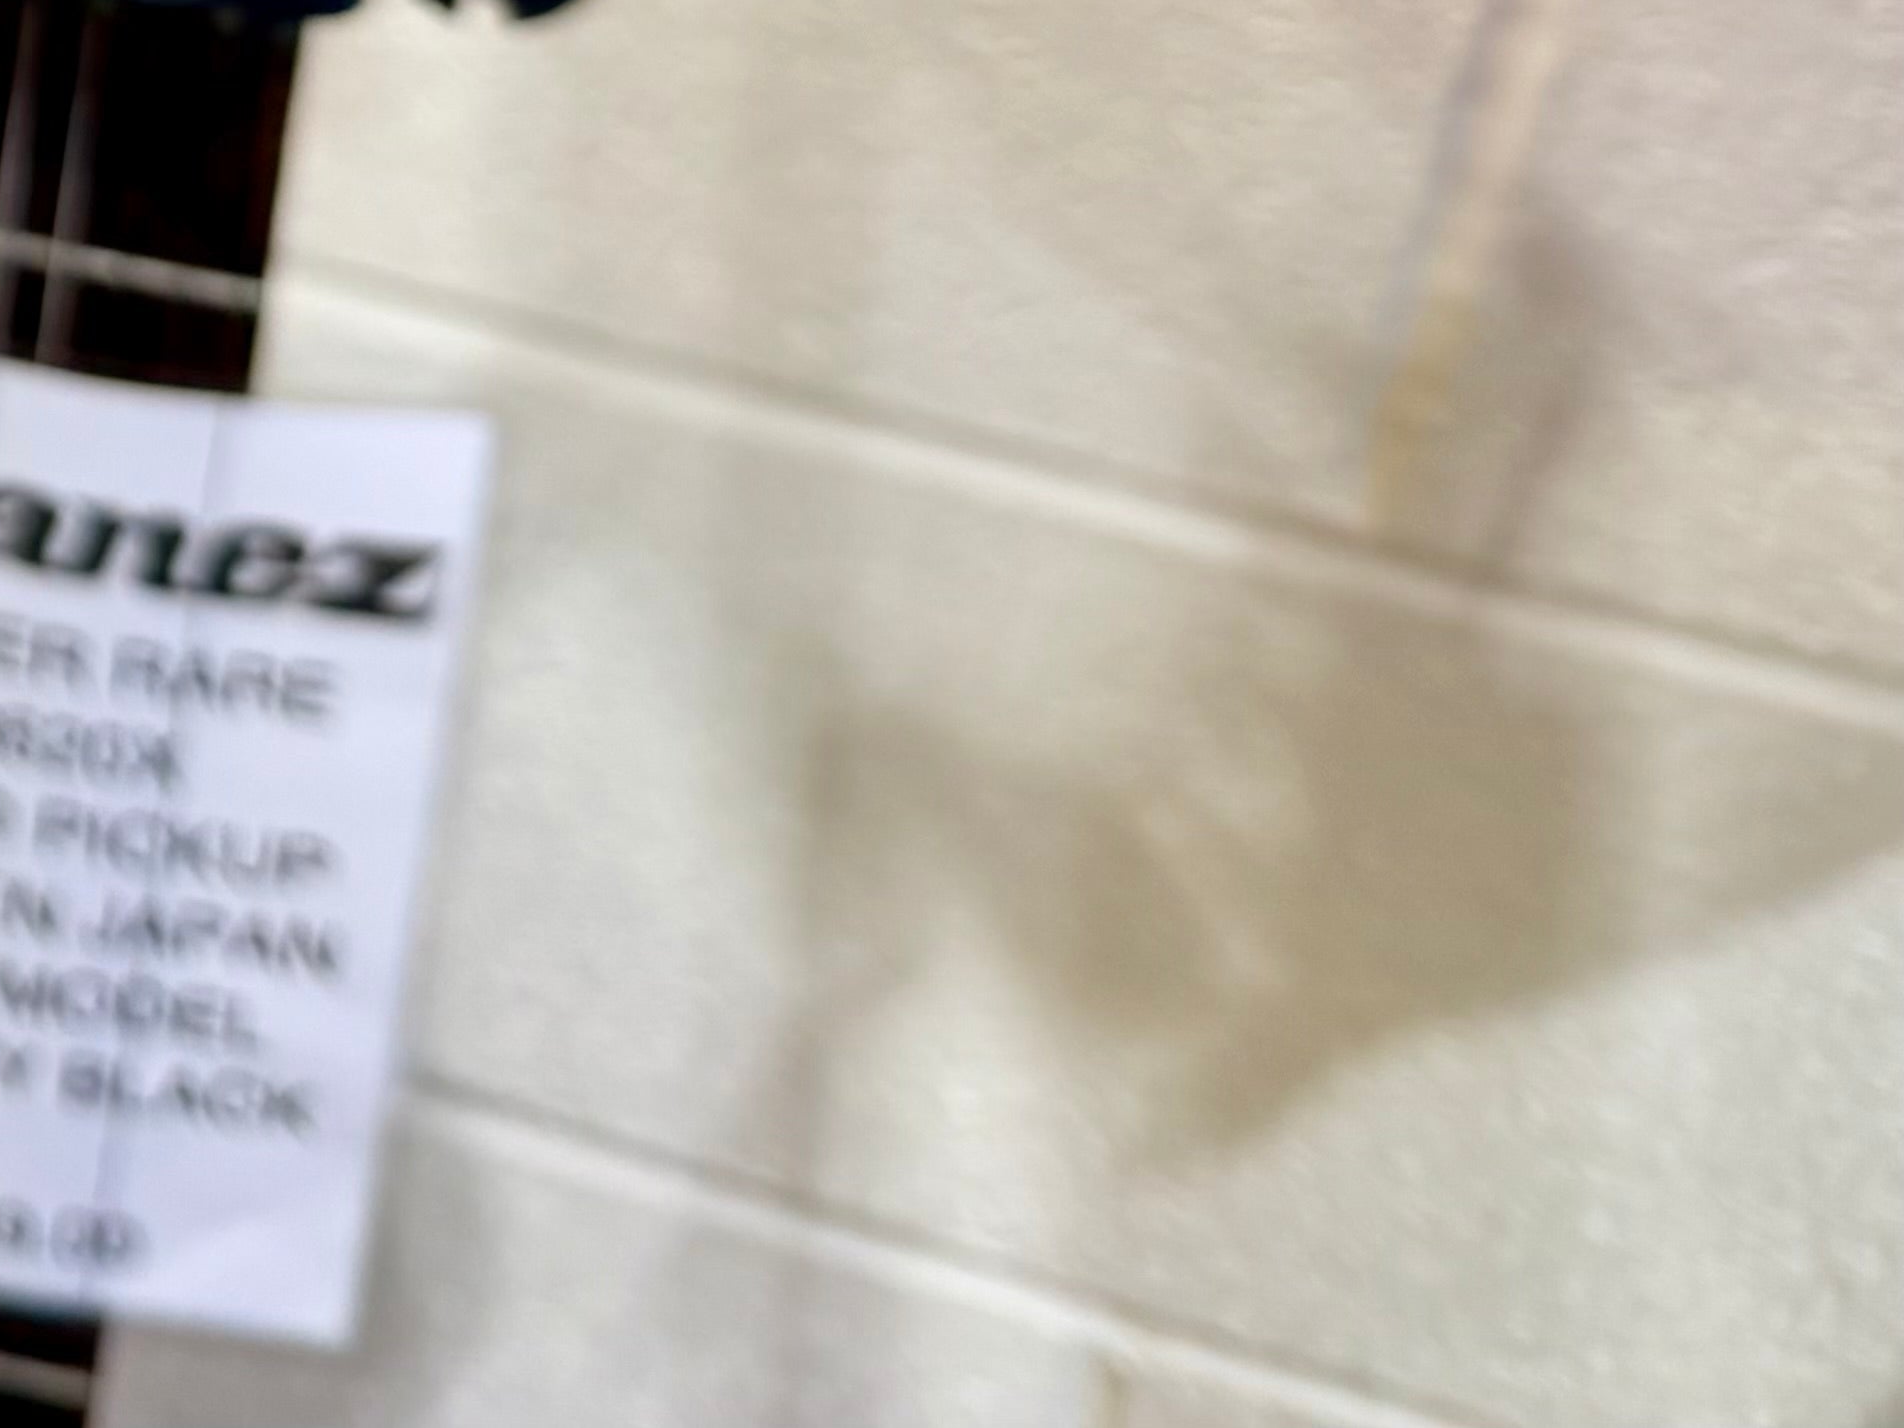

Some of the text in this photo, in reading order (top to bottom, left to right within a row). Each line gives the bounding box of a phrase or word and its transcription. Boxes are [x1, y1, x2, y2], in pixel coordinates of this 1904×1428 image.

[114, 638, 336, 719] RARE
[36, 799, 337, 890] PICKUP
[82, 895, 339, 978] JAPAN
[61, 1053, 313, 1135] BLACK
